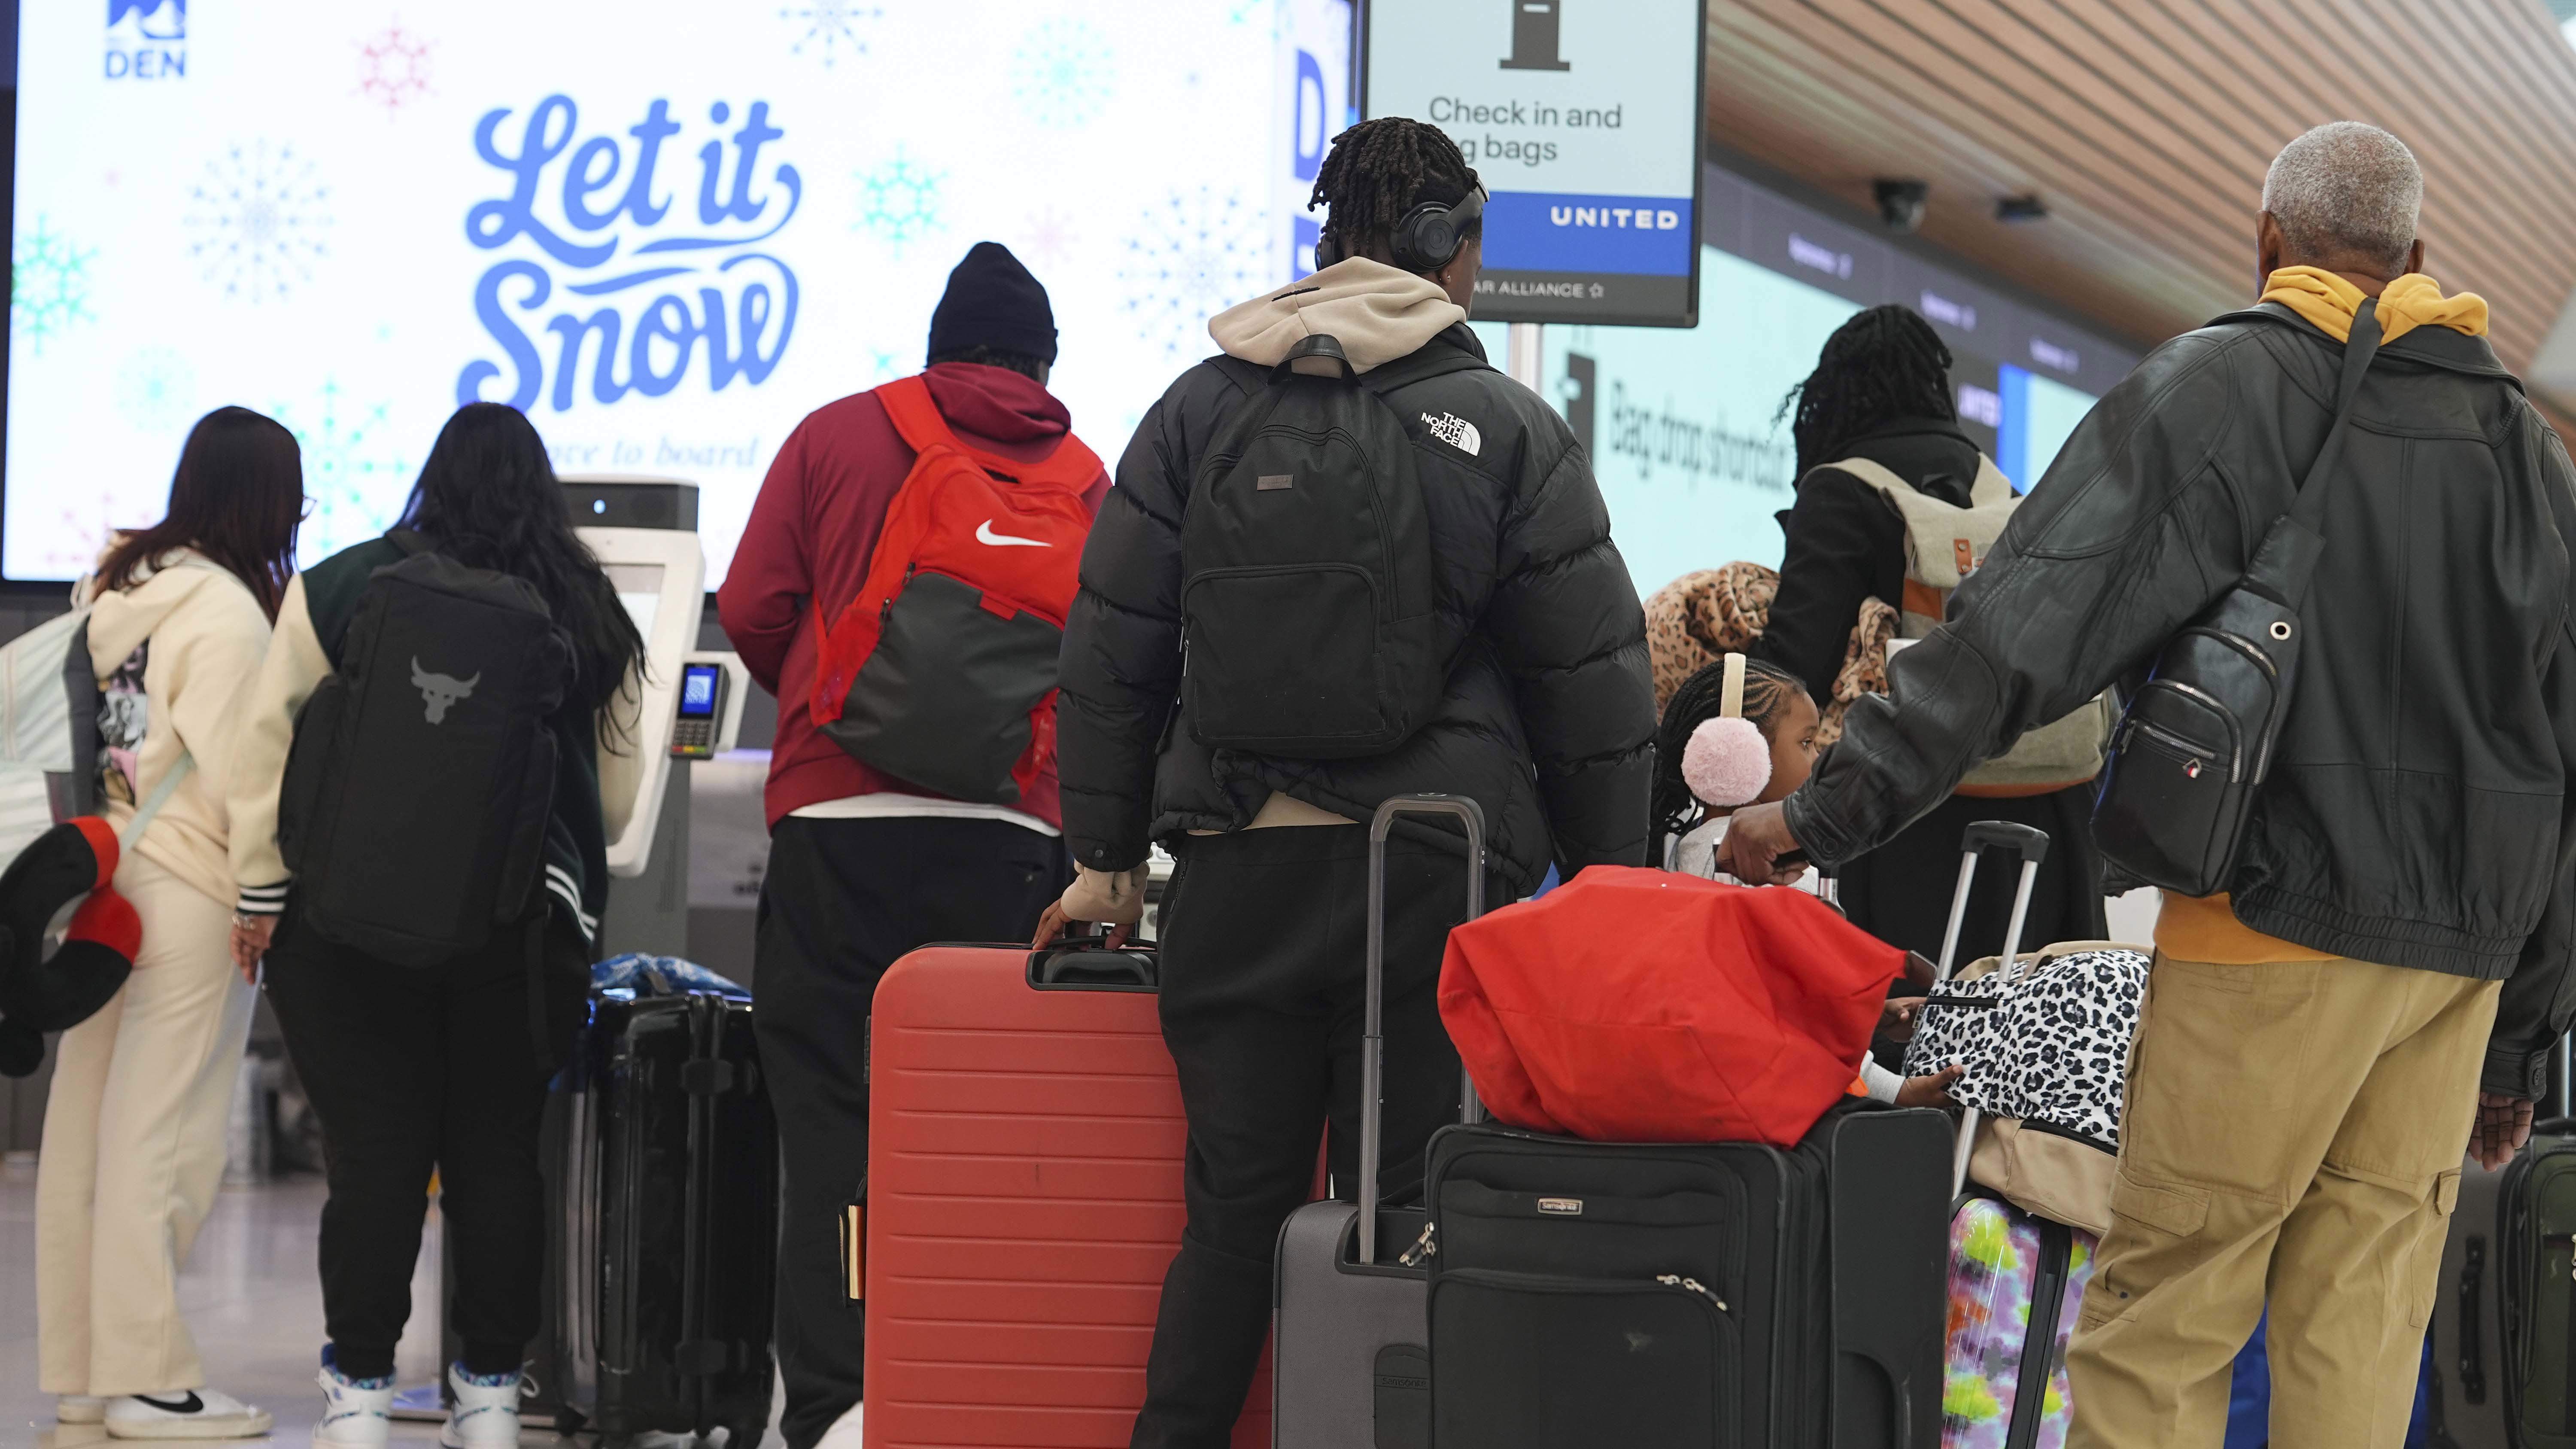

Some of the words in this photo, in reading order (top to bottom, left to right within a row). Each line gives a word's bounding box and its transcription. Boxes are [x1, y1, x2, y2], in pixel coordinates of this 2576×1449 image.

[105, 49, 186, 79] DEN
[1429, 97, 1526, 125] Check
[1534, 102, 1558, 125] in
[1566, 103, 1622, 128] and
[1485, 134, 1558, 167] bags
[465, 94, 681, 268] Let
[699, 102, 784, 226] it
[1550, 205, 1679, 230] UNITED
[1473, 280, 1496, 295] AR
[1498, 280, 1585, 298] ALLIANCE
[456, 254, 799, 415] Snow
[1421, 412, 1463, 438] NORTH
[1443, 411, 1467, 430] THE
[1610, 378, 1651, 480] Bag
[1655, 392, 1702, 493] drop
[654, 434, 760, 466] board
[1430, 425, 1460, 447] FACE
